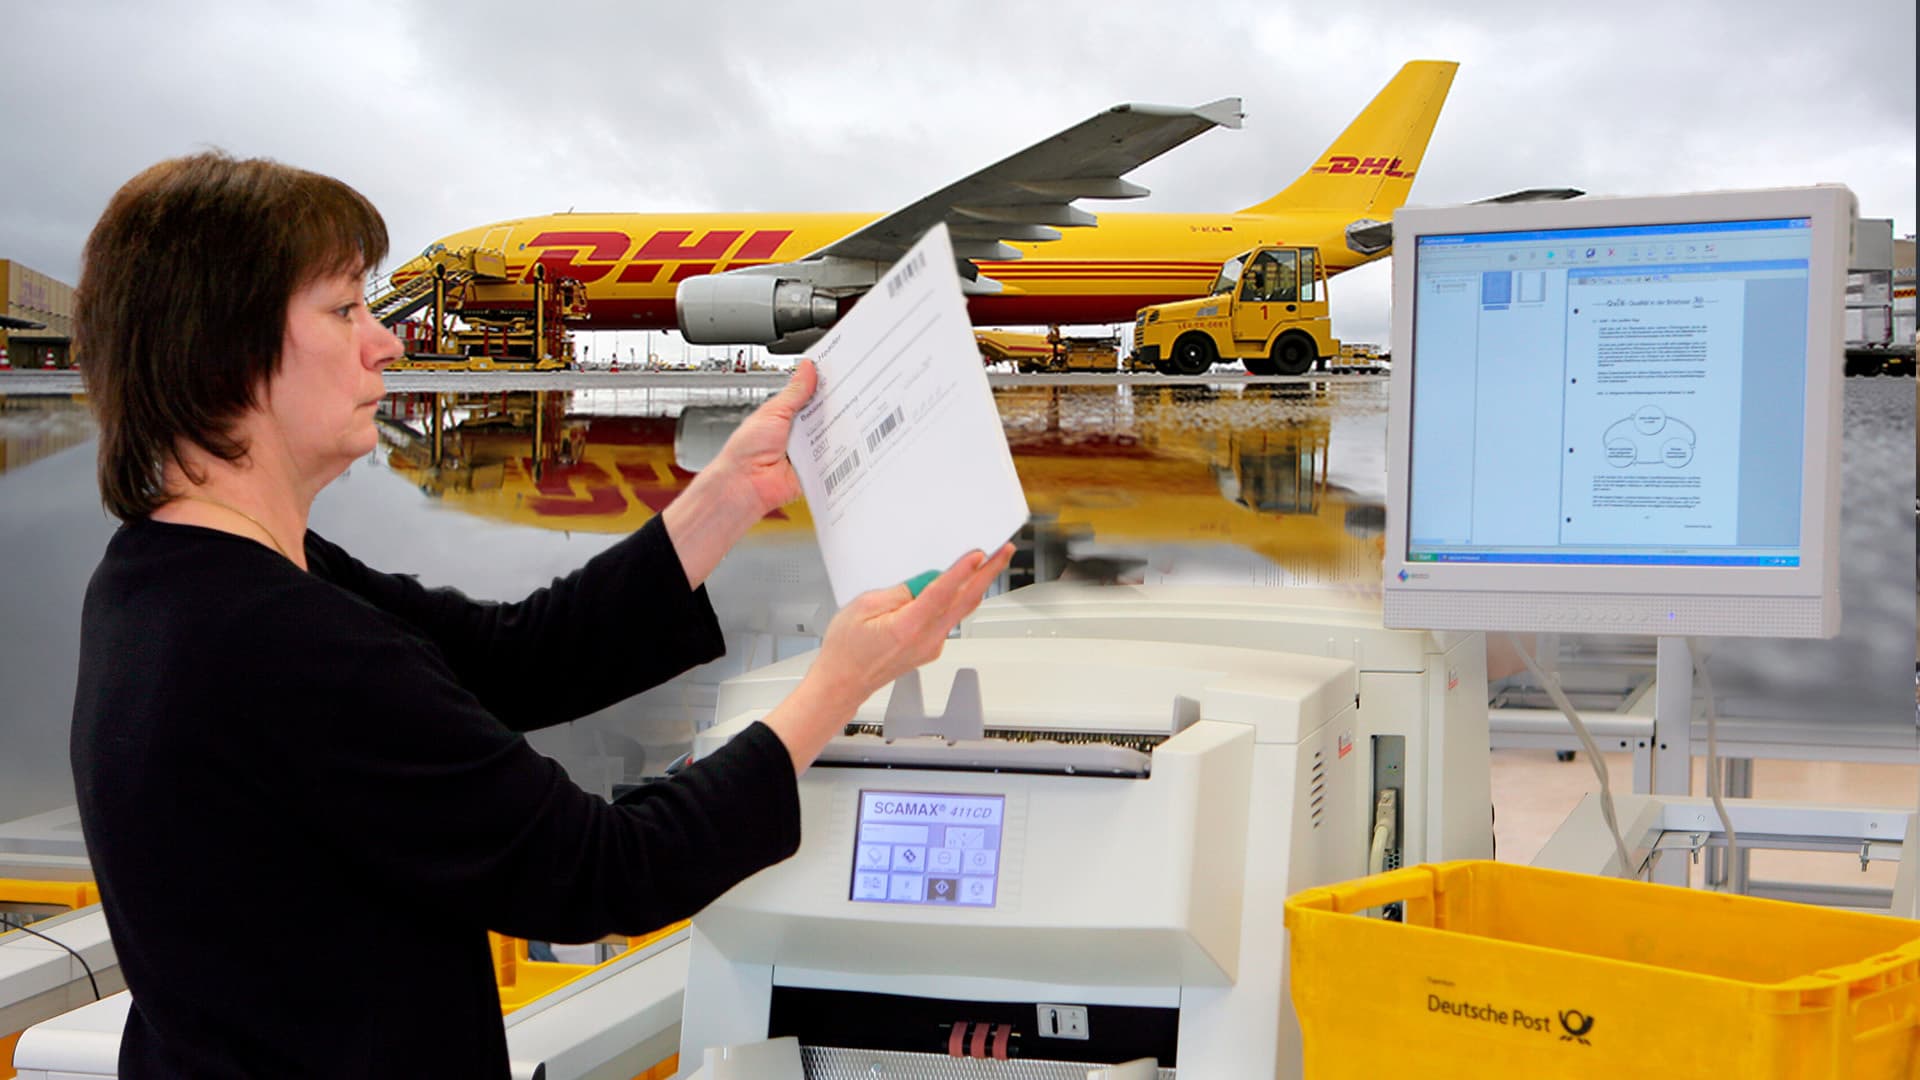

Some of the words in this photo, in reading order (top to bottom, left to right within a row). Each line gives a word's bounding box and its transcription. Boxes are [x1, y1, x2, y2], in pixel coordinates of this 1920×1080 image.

[1327, 156, 1403, 178] DHL
[521, 230, 795, 285] DHL
[1260, 304, 1269, 320] 1
[949, 807, 993, 819] 411CD
[1427, 993, 1509, 1025] Deutsche
[1512, 1009, 1551, 1033] Post
